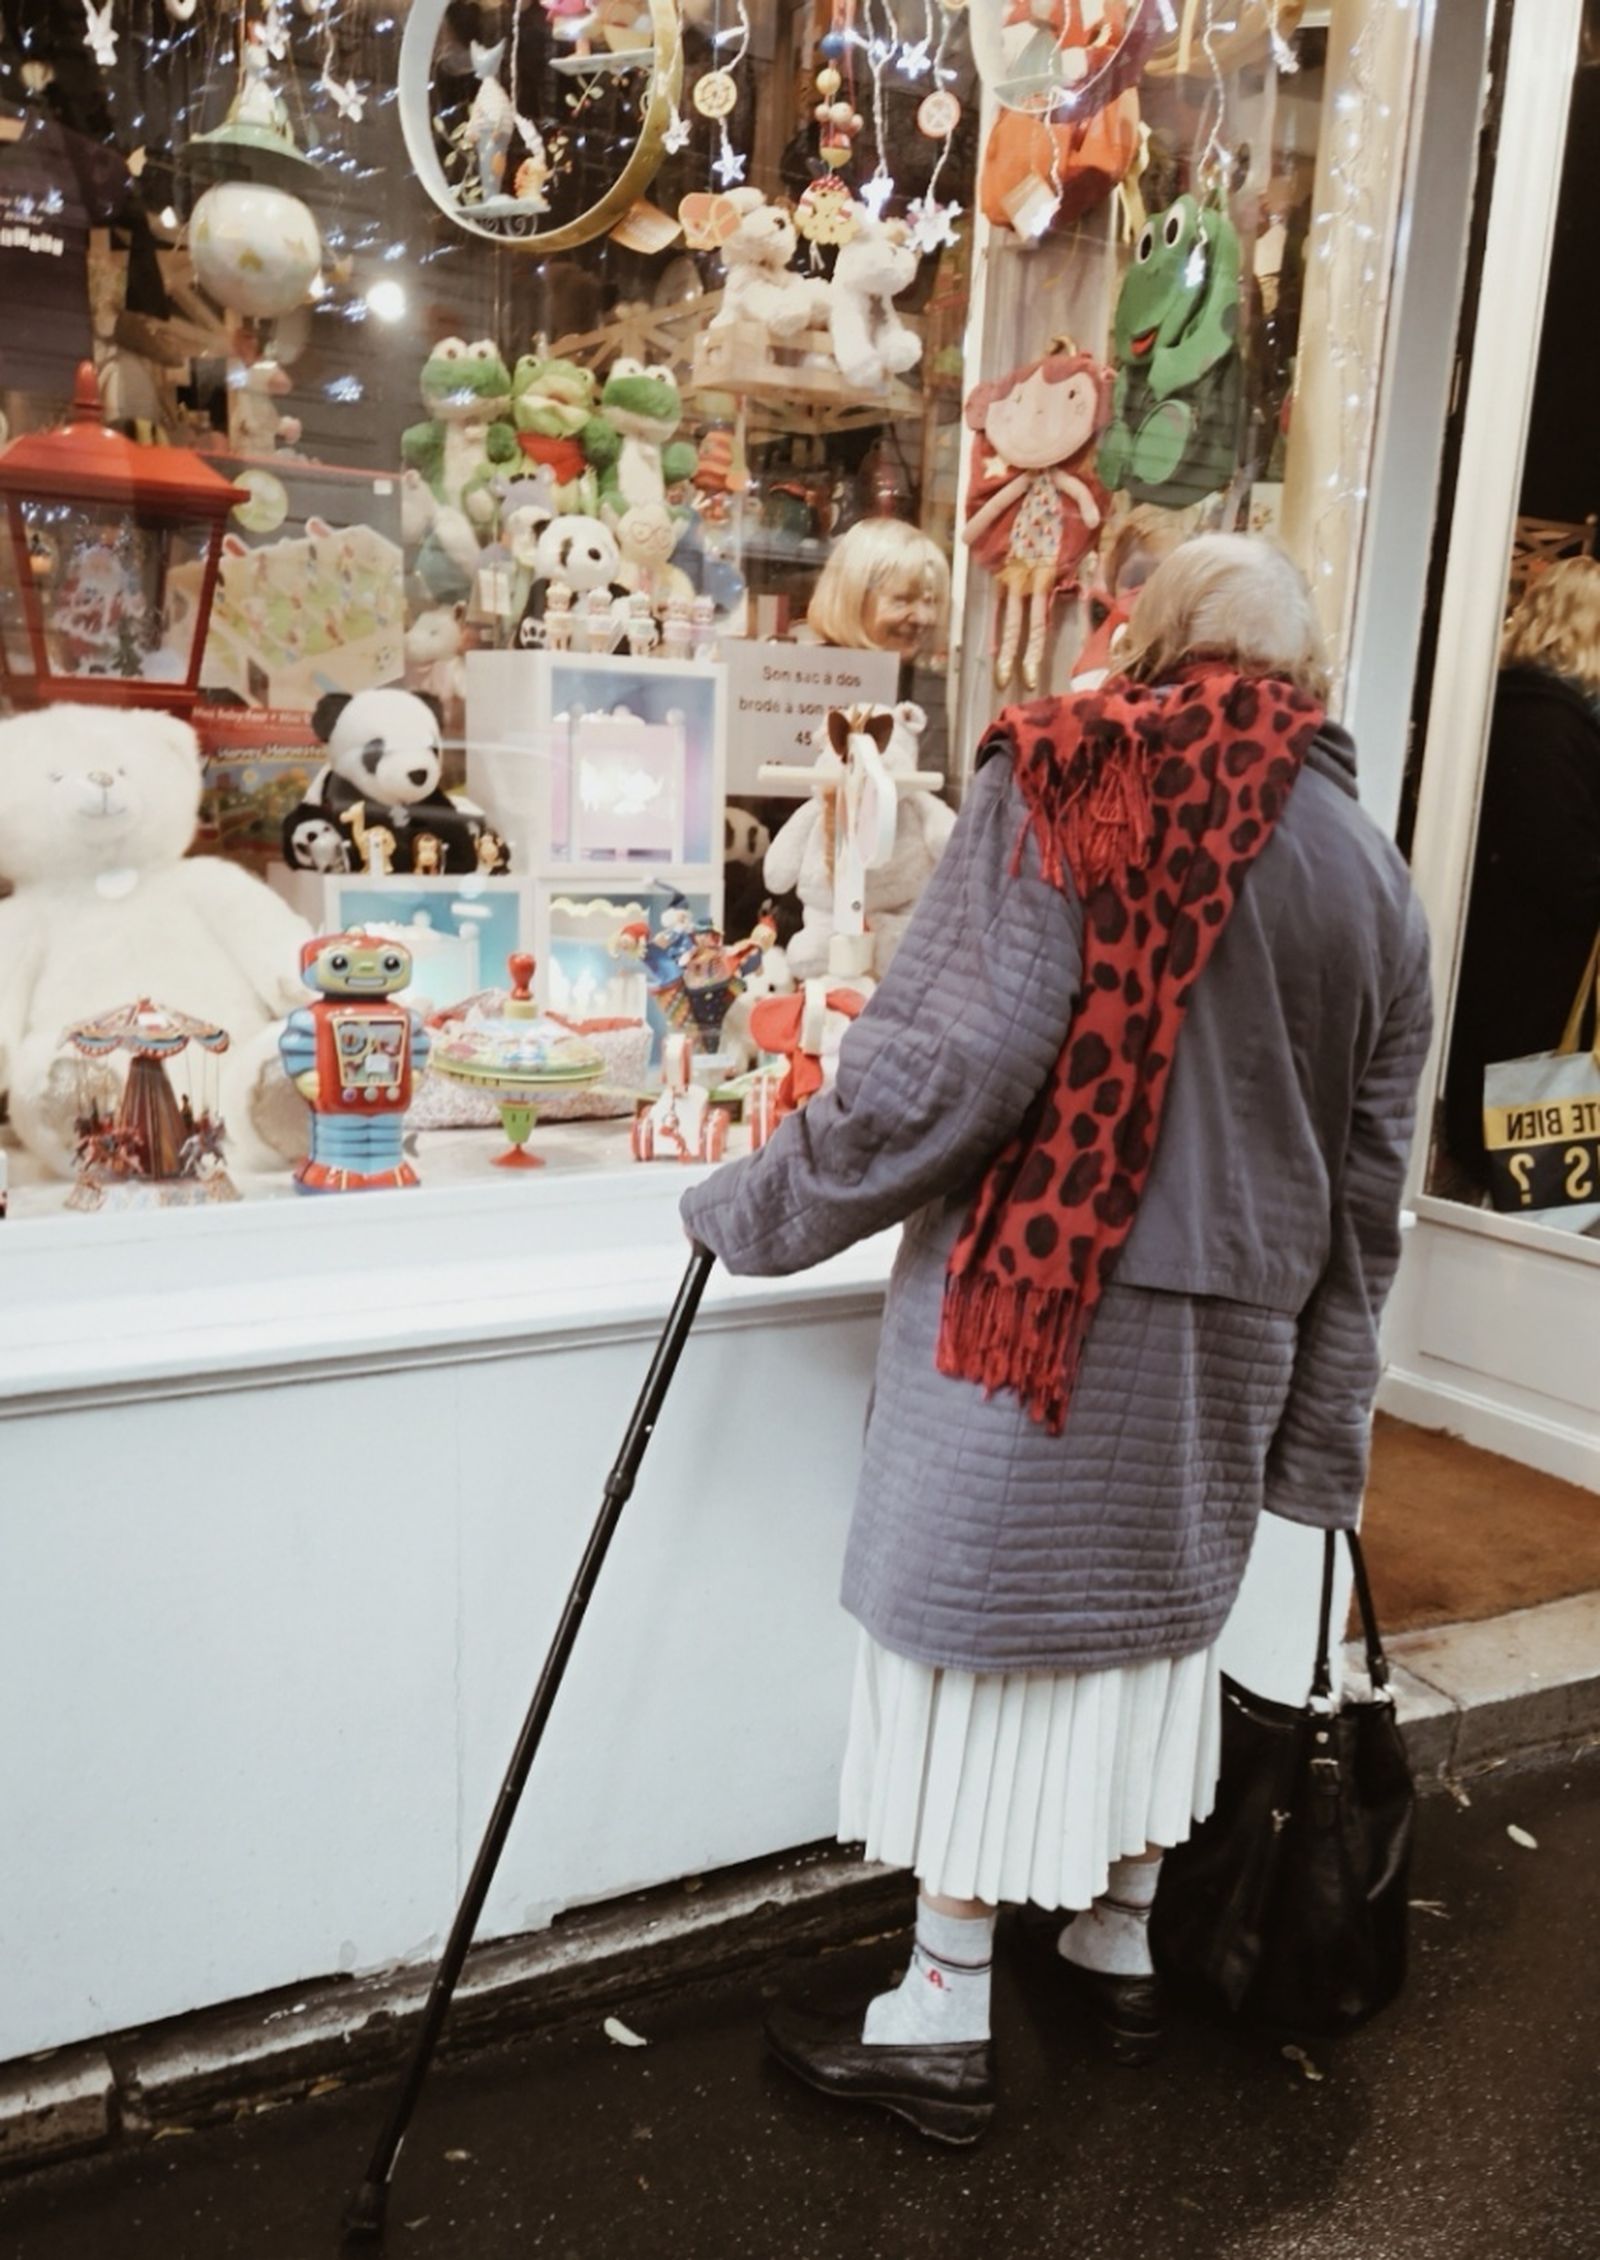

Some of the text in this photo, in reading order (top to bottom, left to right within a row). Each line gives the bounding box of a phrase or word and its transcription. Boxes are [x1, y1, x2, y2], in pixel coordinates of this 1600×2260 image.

[763, 665, 791, 681] Son
[795, 671, 820, 684] sac
[836, 671, 861, 688] dos
[799, 703, 824, 715] son
